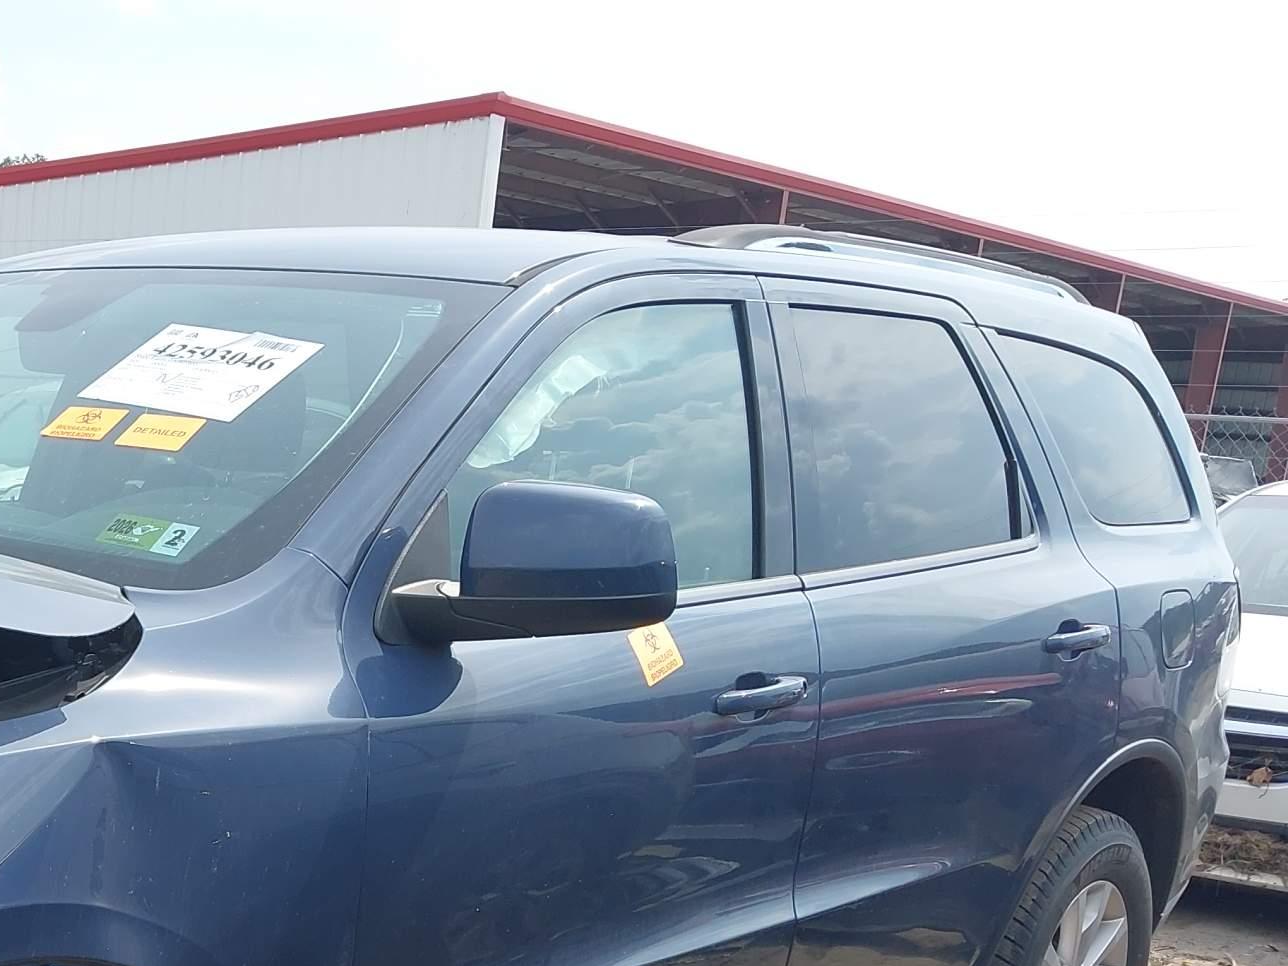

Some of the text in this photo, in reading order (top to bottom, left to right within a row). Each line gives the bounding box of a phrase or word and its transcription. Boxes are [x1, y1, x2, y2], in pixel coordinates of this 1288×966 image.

[153, 341, 280, 371] 42593046
[132, 426, 187, 438] DETAILED
[164, 529, 187, 547] 2
